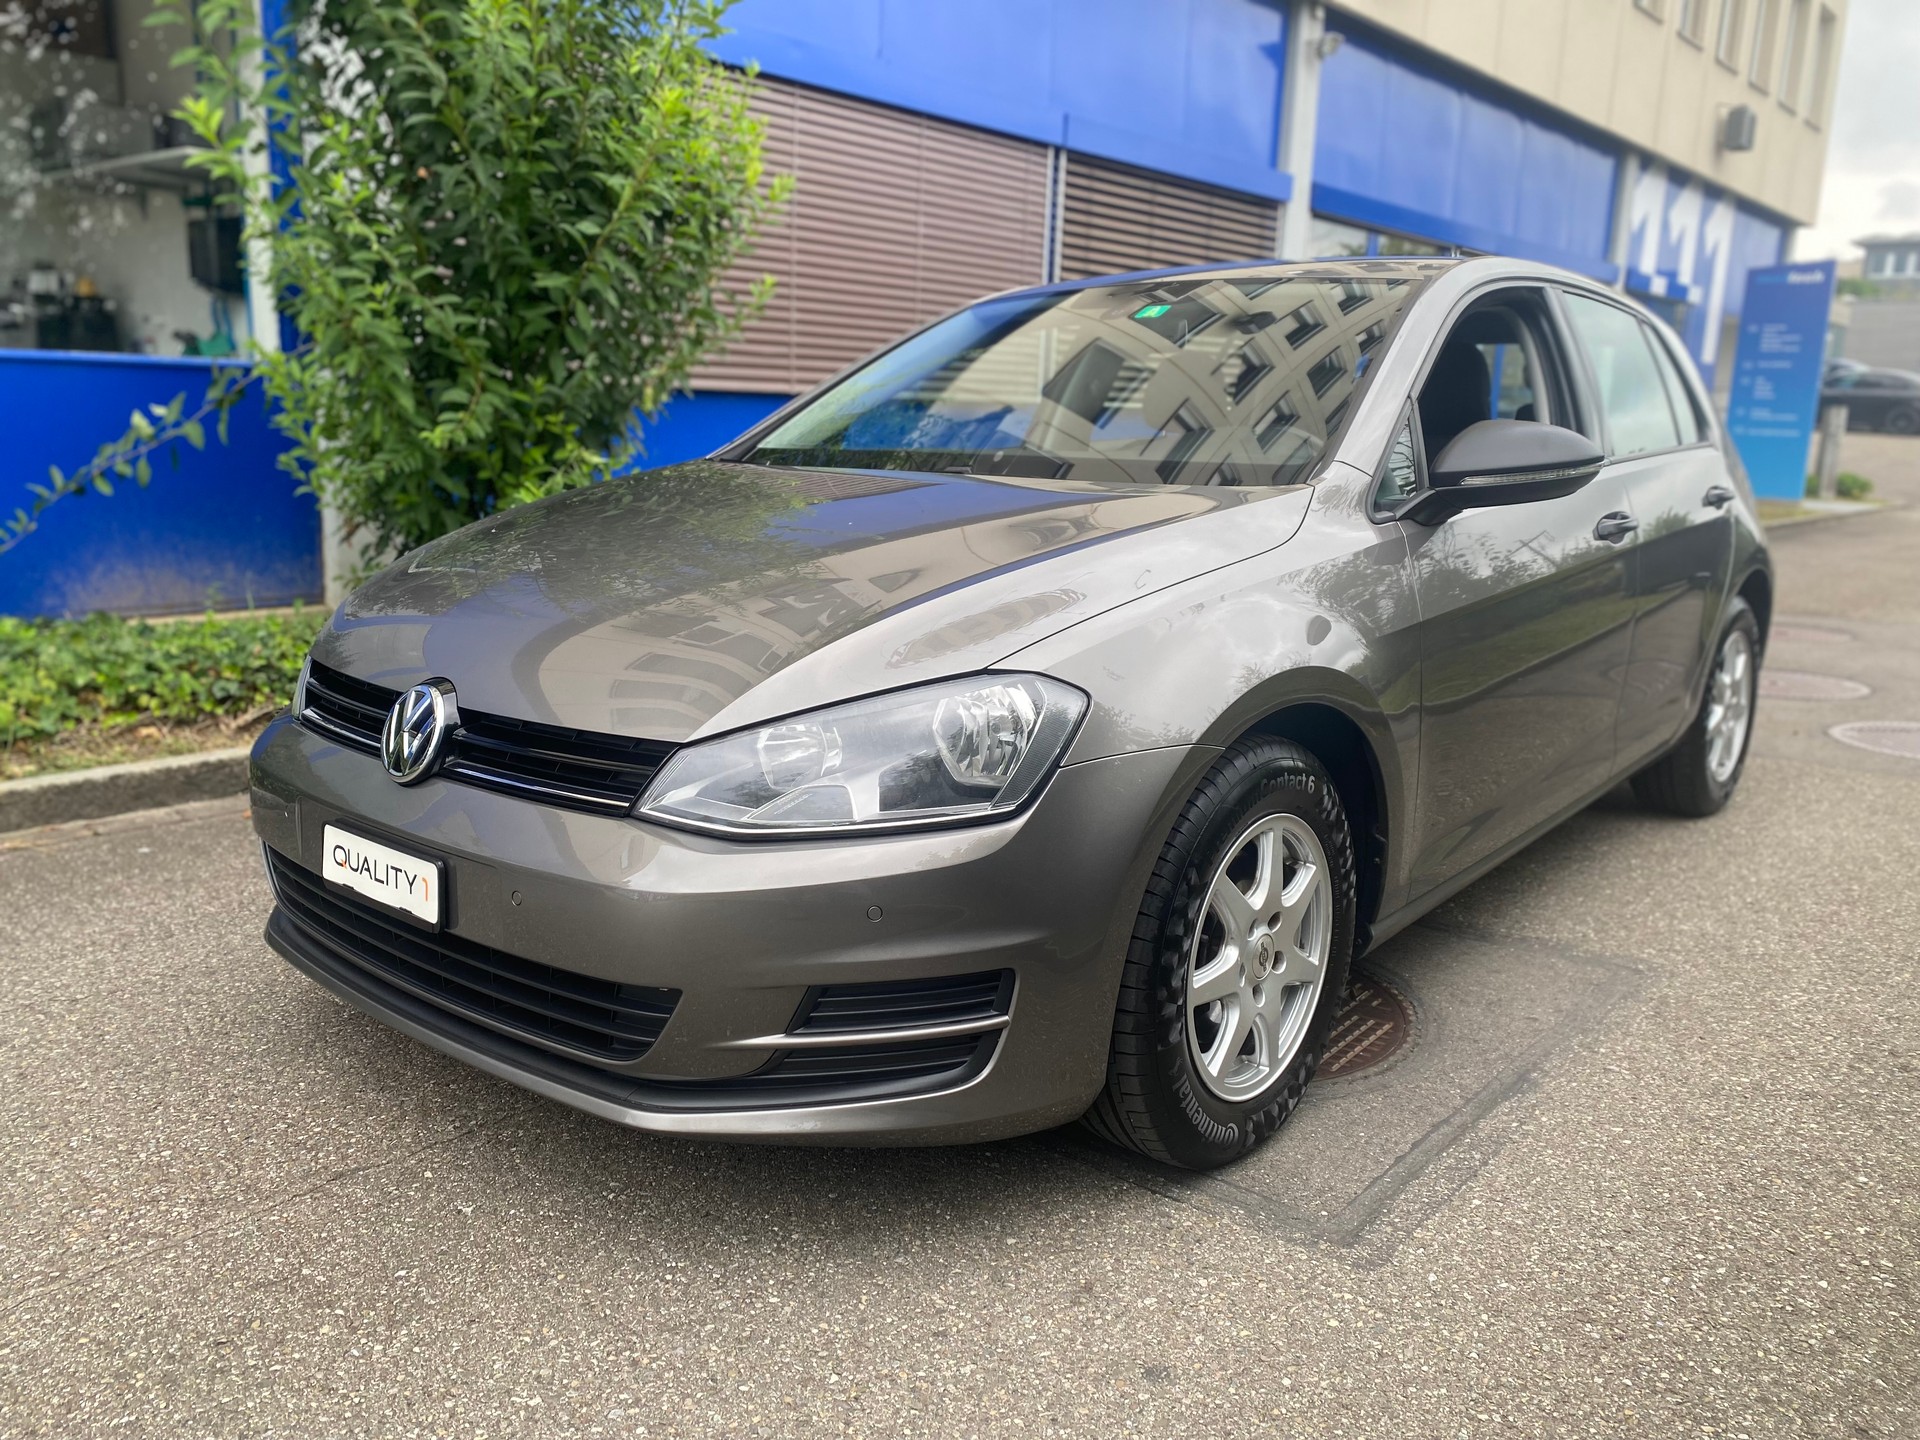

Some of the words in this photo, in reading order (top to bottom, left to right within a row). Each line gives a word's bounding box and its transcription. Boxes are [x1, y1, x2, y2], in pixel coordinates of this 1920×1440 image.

[1261, 772, 1307, 796] Contact
[1307, 775, 1316, 794] 6
[1172, 1073, 1239, 1149] Continental
